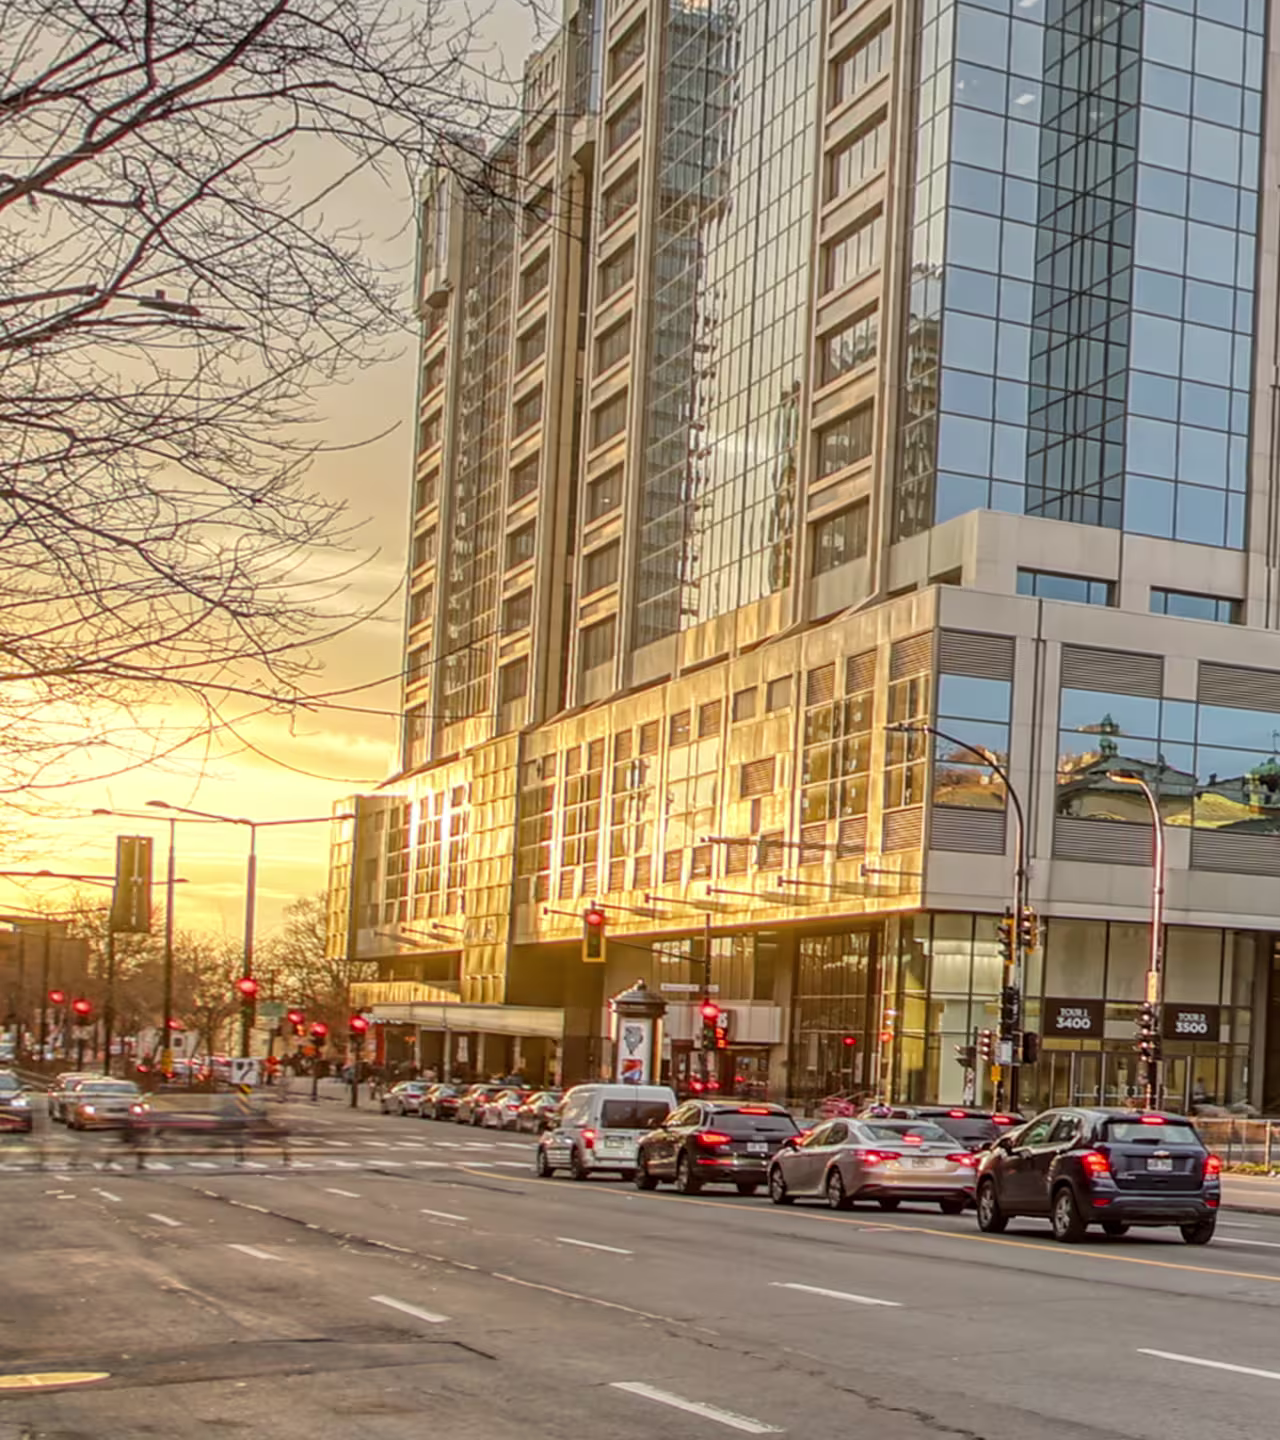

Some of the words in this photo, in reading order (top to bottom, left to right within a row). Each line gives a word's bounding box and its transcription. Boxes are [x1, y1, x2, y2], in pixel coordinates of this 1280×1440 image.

[1060, 1008, 1082, 1017] TOUR
[1178, 1013, 1199, 1021] TOUR
[1056, 1017, 1091, 1029] 3400
[1175, 1022, 1208, 1033] 3500
